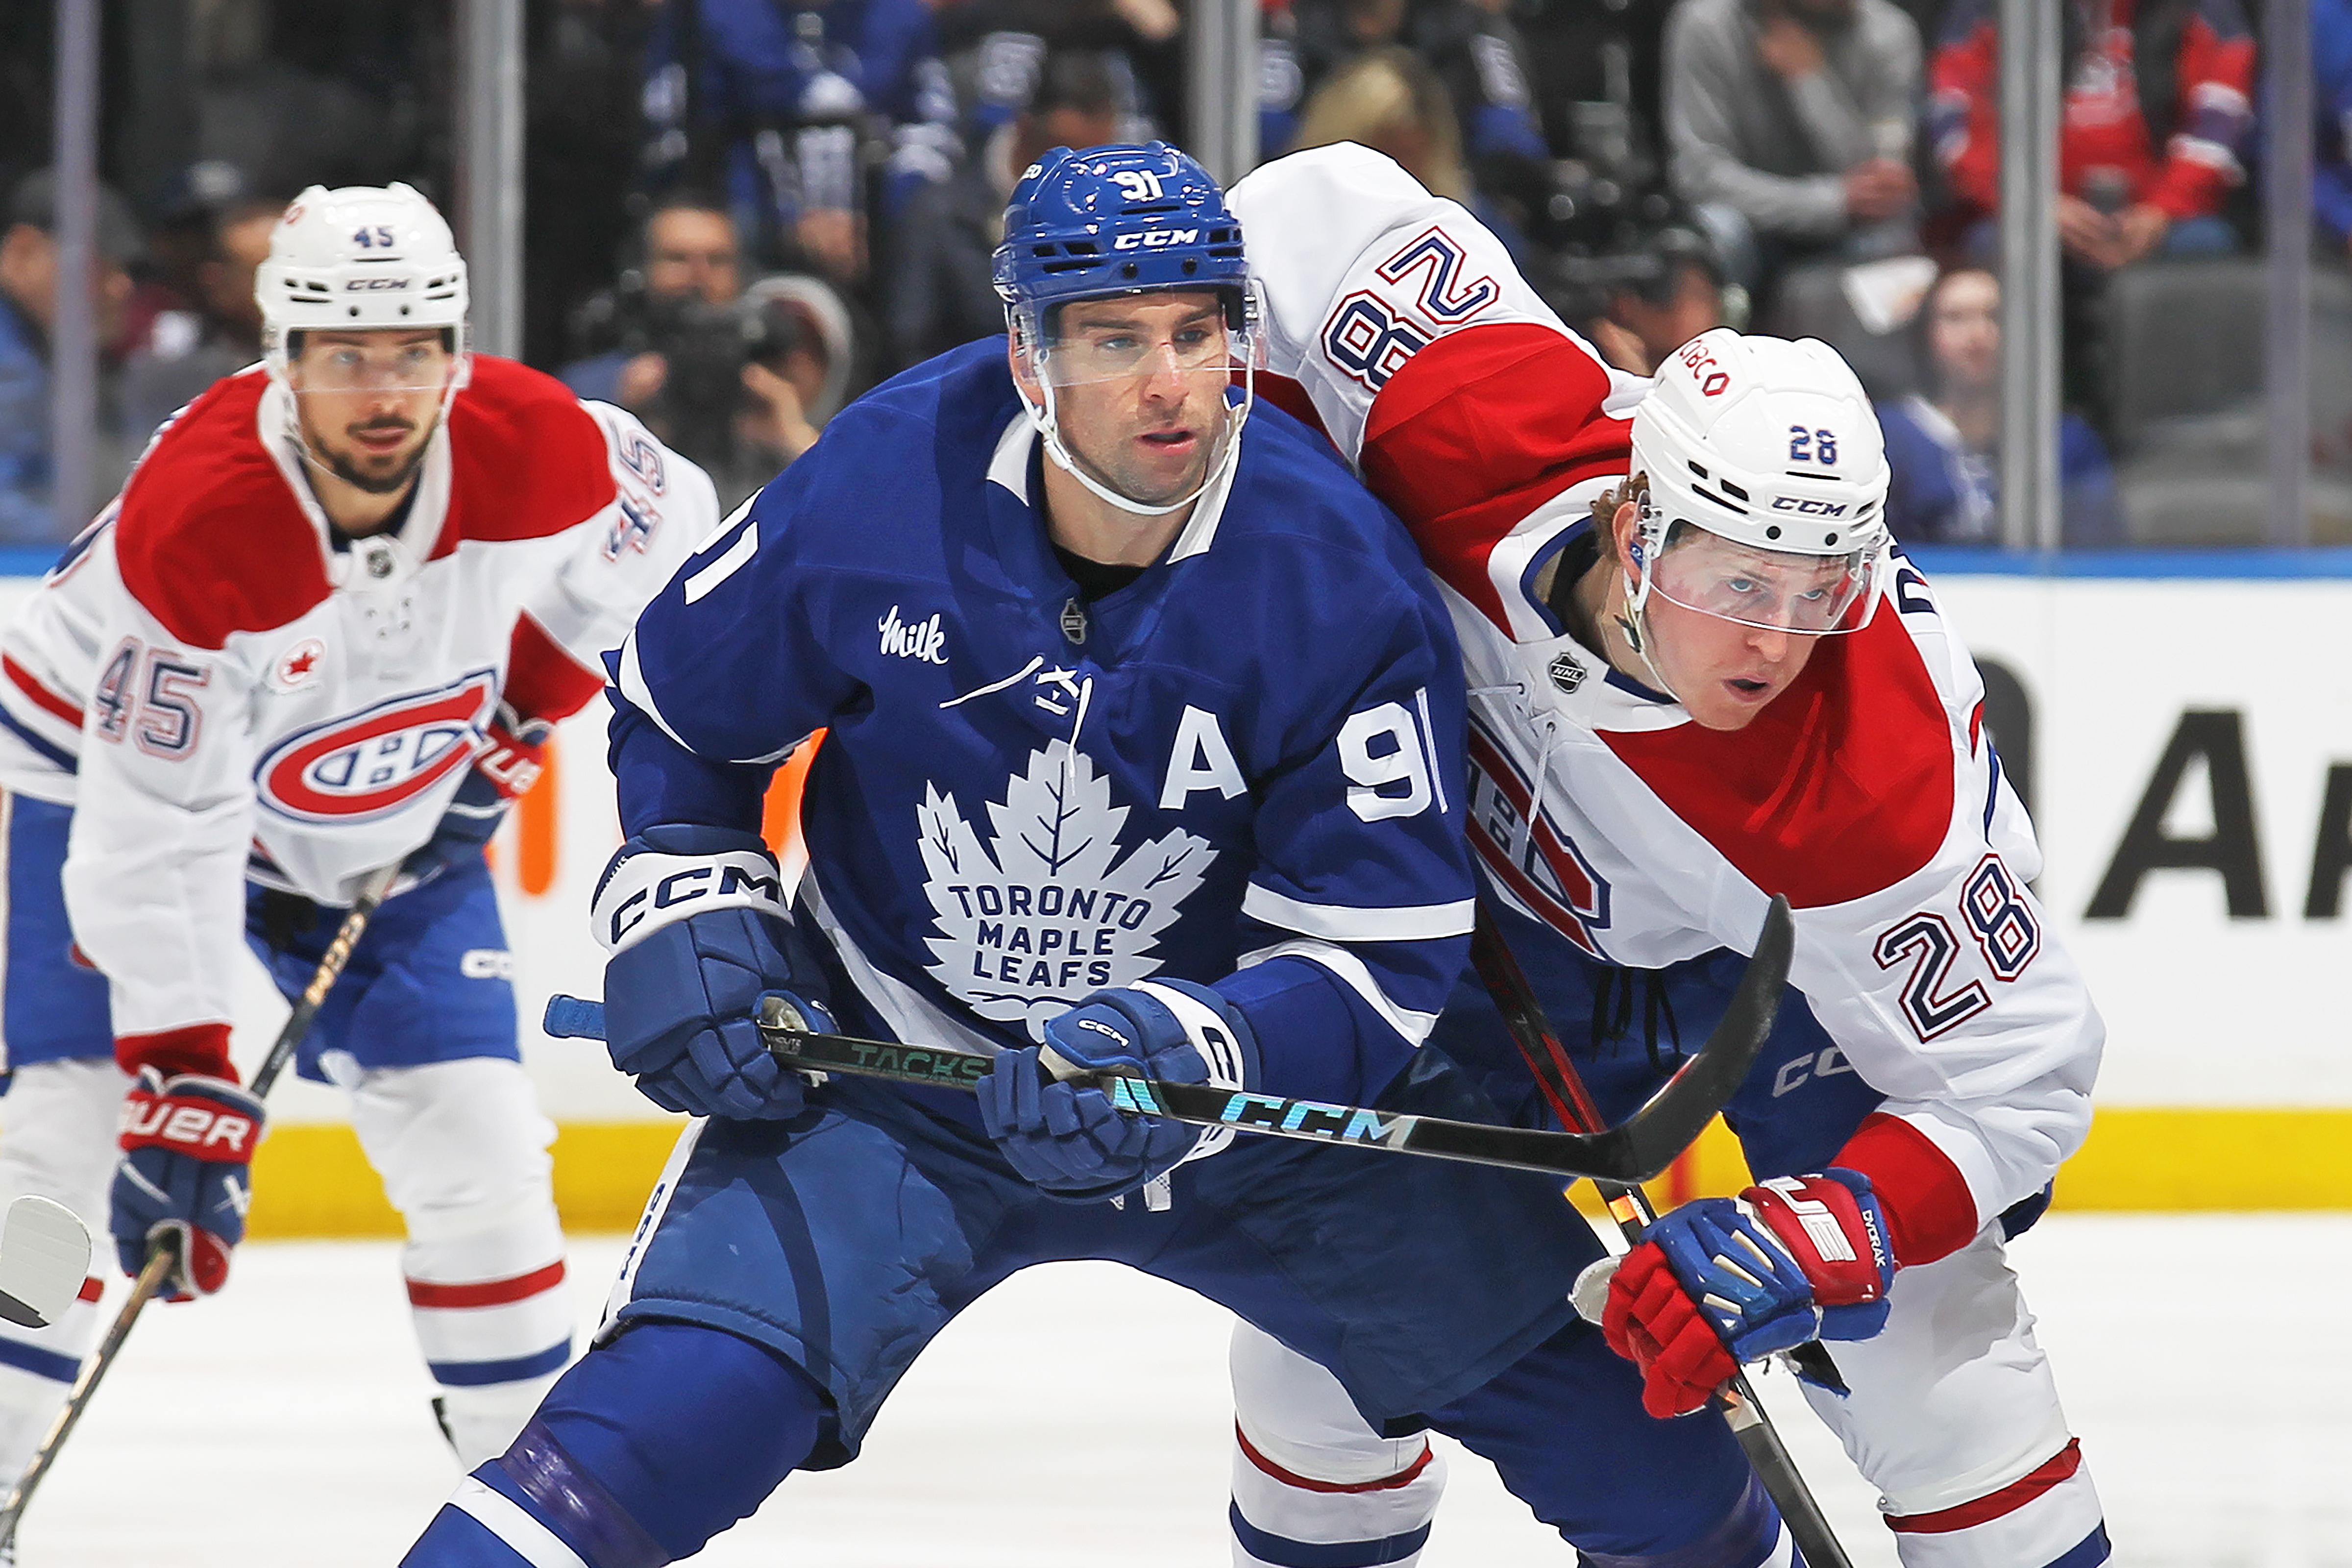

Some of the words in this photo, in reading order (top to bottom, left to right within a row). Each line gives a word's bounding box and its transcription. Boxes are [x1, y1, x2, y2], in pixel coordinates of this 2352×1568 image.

[1113, 170, 1165, 200] 91
[353, 227, 395, 247] 45
[1113, 229, 1199, 250] CCM
[345, 279, 410, 291] CCM
[1321, 224, 1500, 394] 28
[1789, 425, 1838, 466] 28
[1771, 496, 1848, 517] CCM
[878, 605, 949, 664] Milk
[96, 635, 211, 762] 45
[1159, 704, 1248, 809] A
[1336, 686, 1448, 822] 91
[611, 866, 780, 944] CCM
[948, 885, 1152, 931] TORONTO
[977, 919, 1116, 956] MAPLE
[1873, 853, 2041, 1044] 28
[461, 949, 513, 980] CC
[973, 951, 1111, 987] LEAFS
[1078, 1019, 1129, 1047] CCM
[851, 1043, 987, 1085] TACKS
[1773, 1046, 1854, 1098] CC
[1221, 1092, 1419, 1150] CCM
[1862, 1209, 1886, 1268] DVORAK
